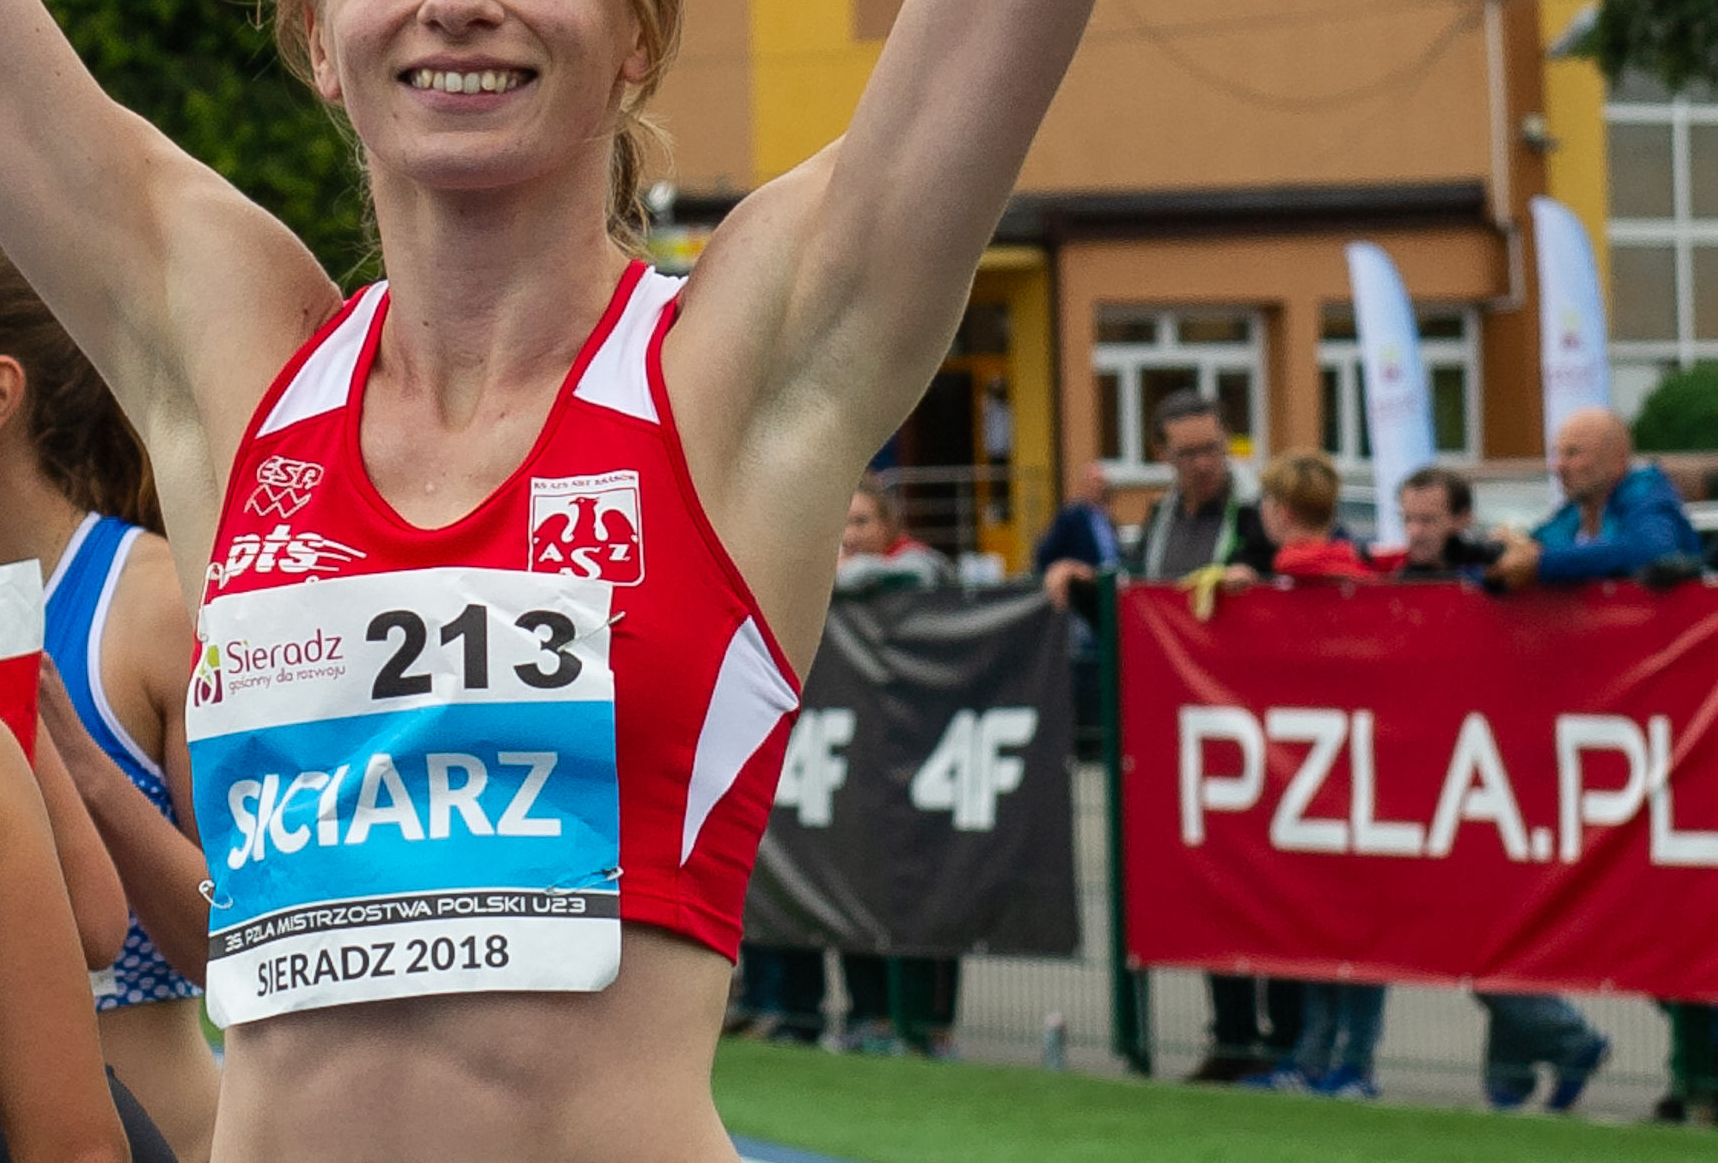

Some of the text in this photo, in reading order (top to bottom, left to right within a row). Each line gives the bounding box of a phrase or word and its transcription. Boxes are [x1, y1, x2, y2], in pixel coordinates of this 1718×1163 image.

[226, 628, 344, 674] Sieradz
[365, 604, 583, 700] 213
[227, 751, 562, 870] SICIARZ
[776, 706, 857, 827] 4F
[909, 705, 1039, 831] 4F
[1177, 704, 1718, 867] PZLA.PL
[245, 922, 276, 945] PZLA
[277, 900, 432, 936] MISTRZOSTWA
[437, 896, 526, 915] POLSKI
[532, 896, 586, 914] U23
[257, 934, 510, 997] SIERADZ 2018
